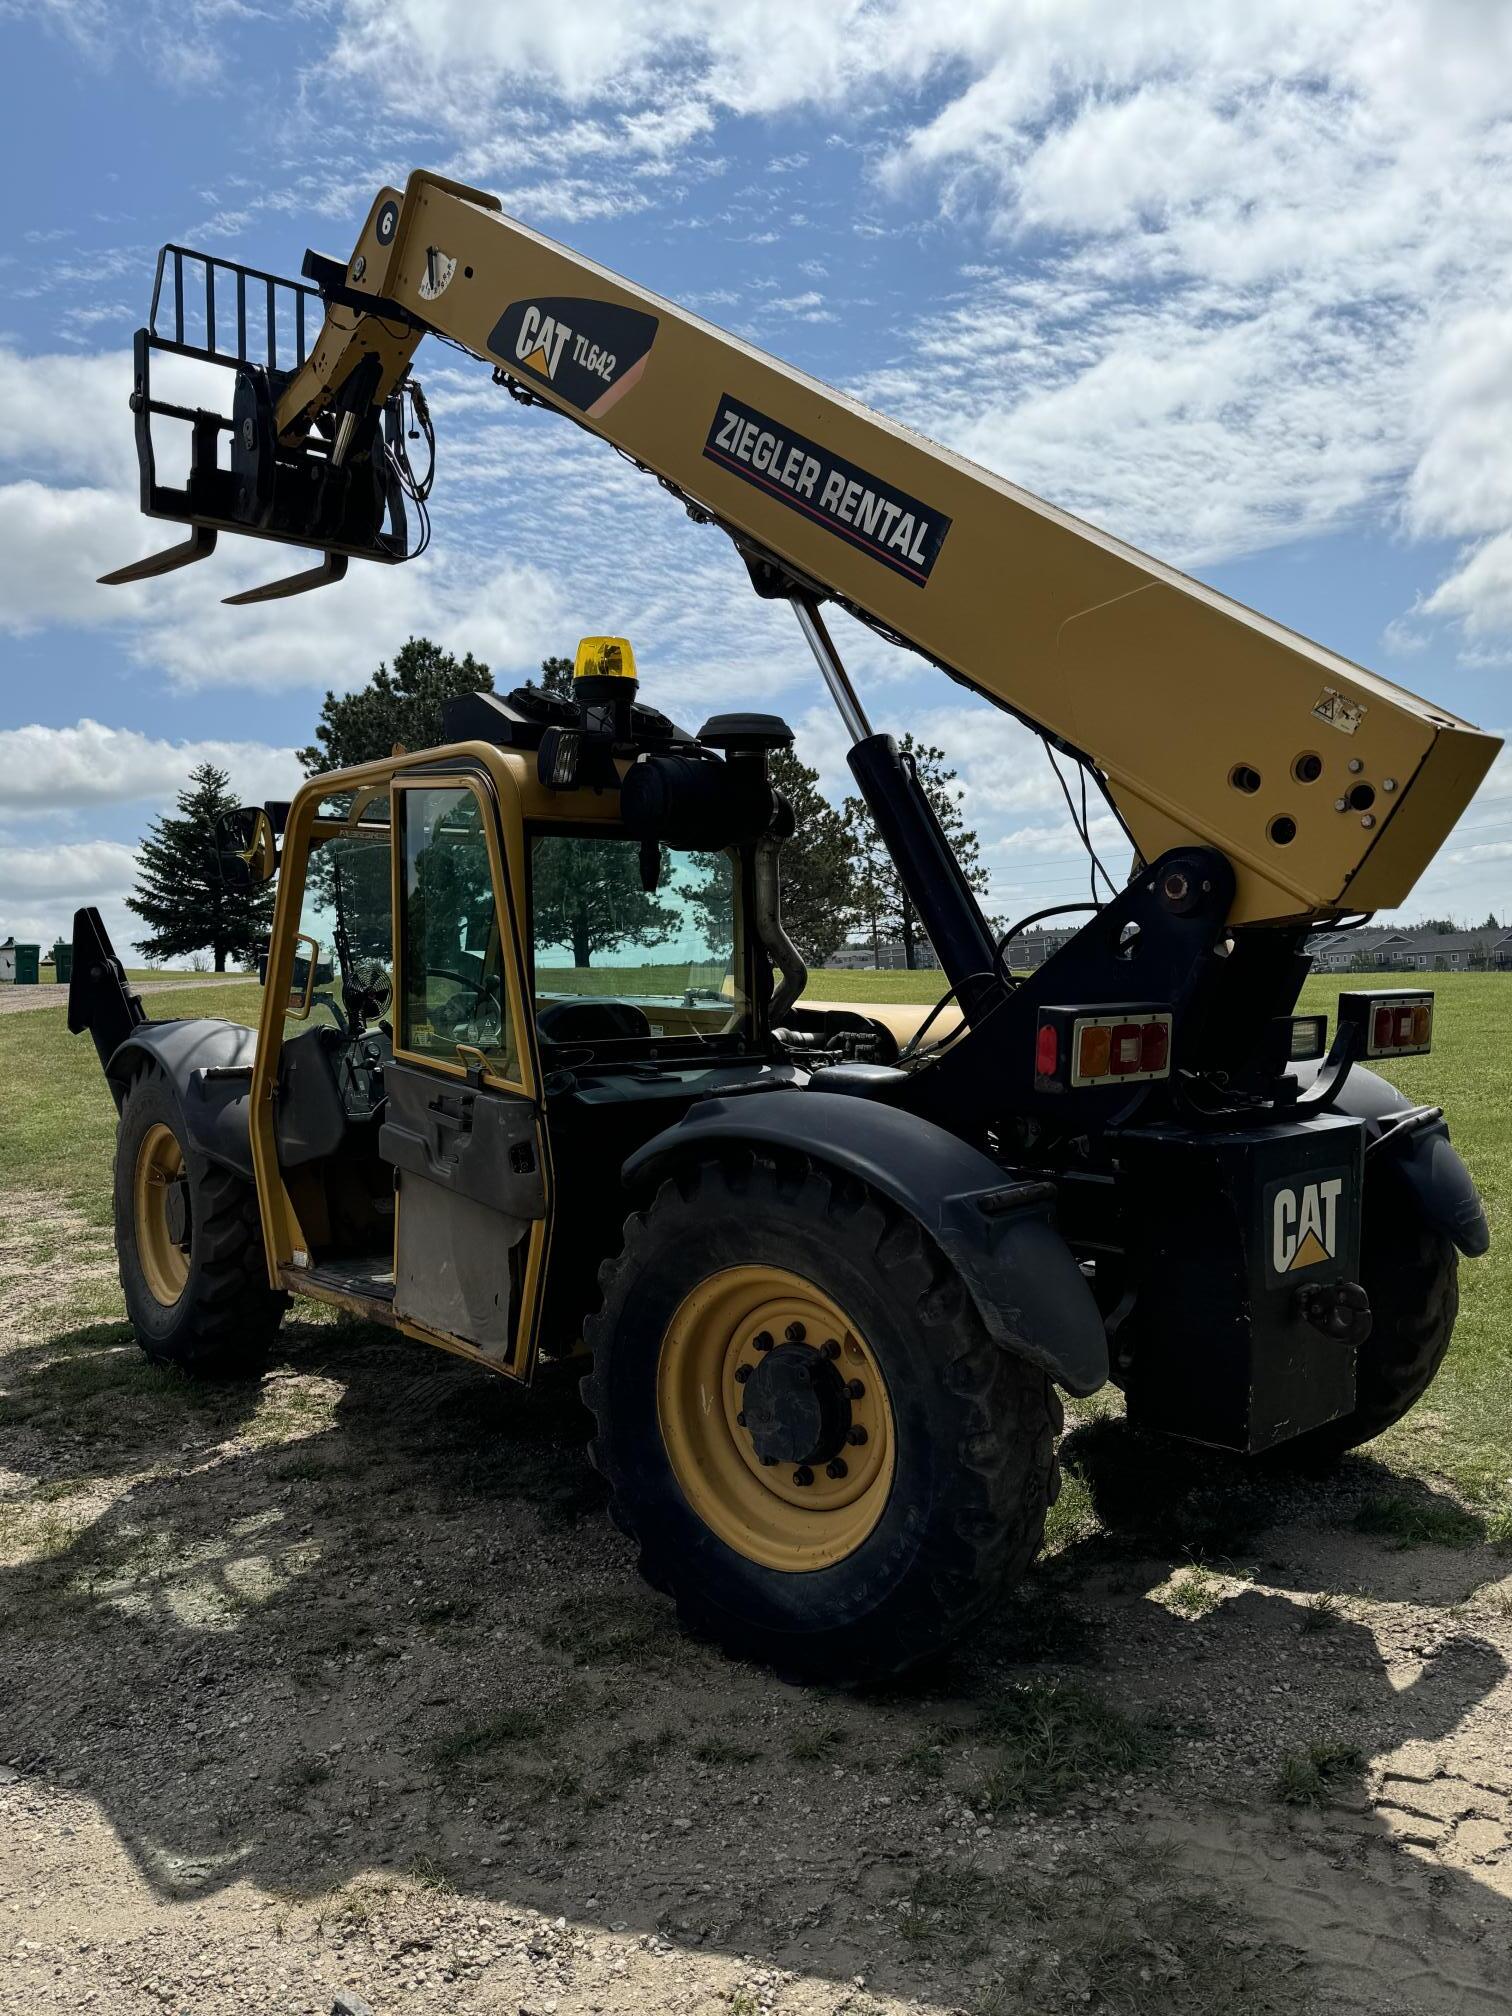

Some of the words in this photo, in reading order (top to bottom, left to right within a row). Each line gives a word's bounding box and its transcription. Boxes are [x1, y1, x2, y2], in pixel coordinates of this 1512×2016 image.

[381, 211, 393, 235] 6
[515, 306, 573, 381] CAT
[573, 334, 617, 382] TL642
[715, 410, 822, 499] ZIEGLER
[819, 469, 929, 566] RENTAL
[1273, 1178, 1342, 1274] CAT
